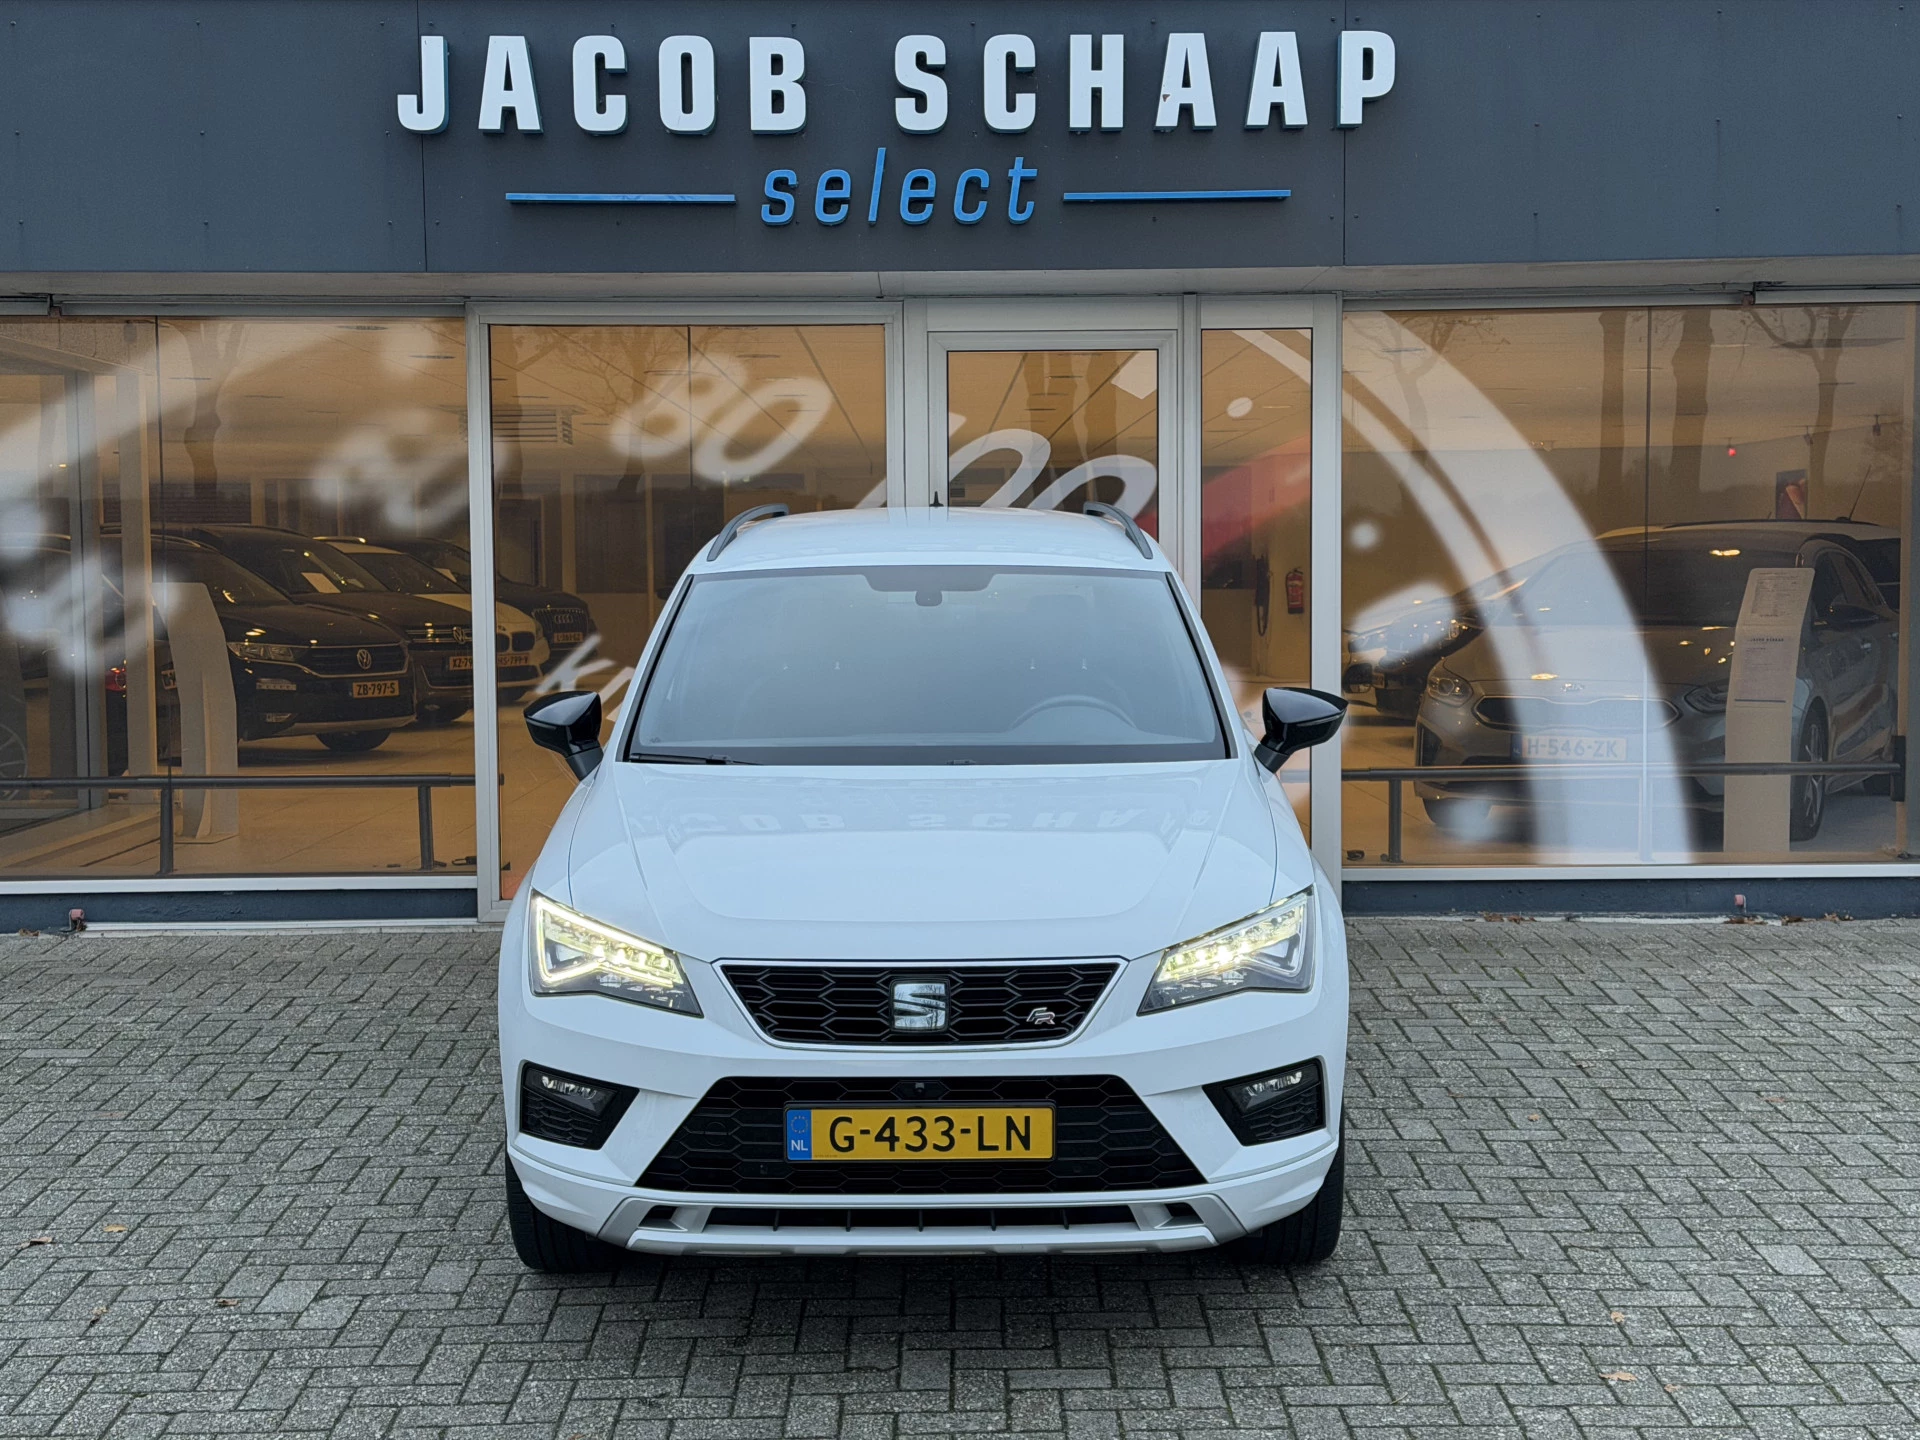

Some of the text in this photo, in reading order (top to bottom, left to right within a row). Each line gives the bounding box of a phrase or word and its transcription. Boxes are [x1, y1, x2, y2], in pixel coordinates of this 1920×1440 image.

[397, 29, 1397, 135] JACOB SCHAAP
[760, 147, 1038, 226] select
[357, 683, 396, 696] ZB-797-S
[1527, 738, 1618, 758] H-546-ZK
[790, 1140, 809, 1152] NL
[829, 1115, 1031, 1153] G-433-LN
